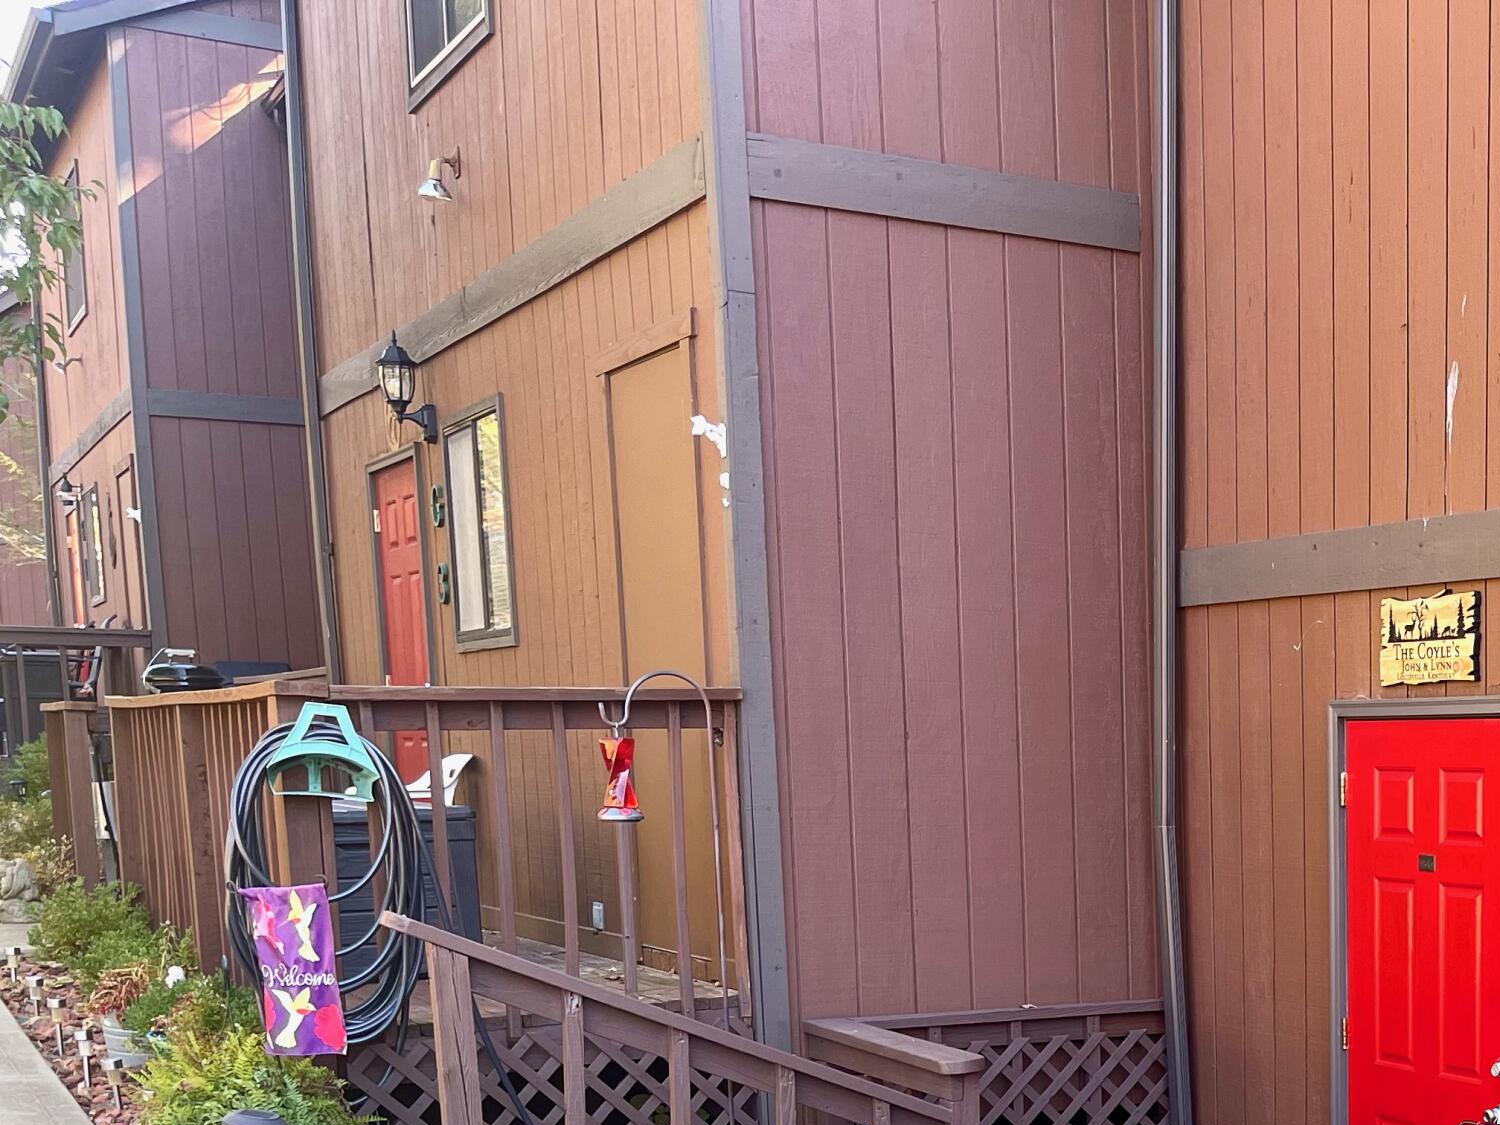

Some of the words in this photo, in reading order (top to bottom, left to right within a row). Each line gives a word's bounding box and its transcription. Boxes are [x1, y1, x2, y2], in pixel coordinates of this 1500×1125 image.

[431, 484, 445, 528] G
[1393, 644, 1414, 660] THE
[1418, 641, 1460, 659] COYLE'S
[1401, 660, 1421, 674] JOHN
[1431, 659, 1451, 670] LYNN
[261, 963, 335, 987] Welcome
